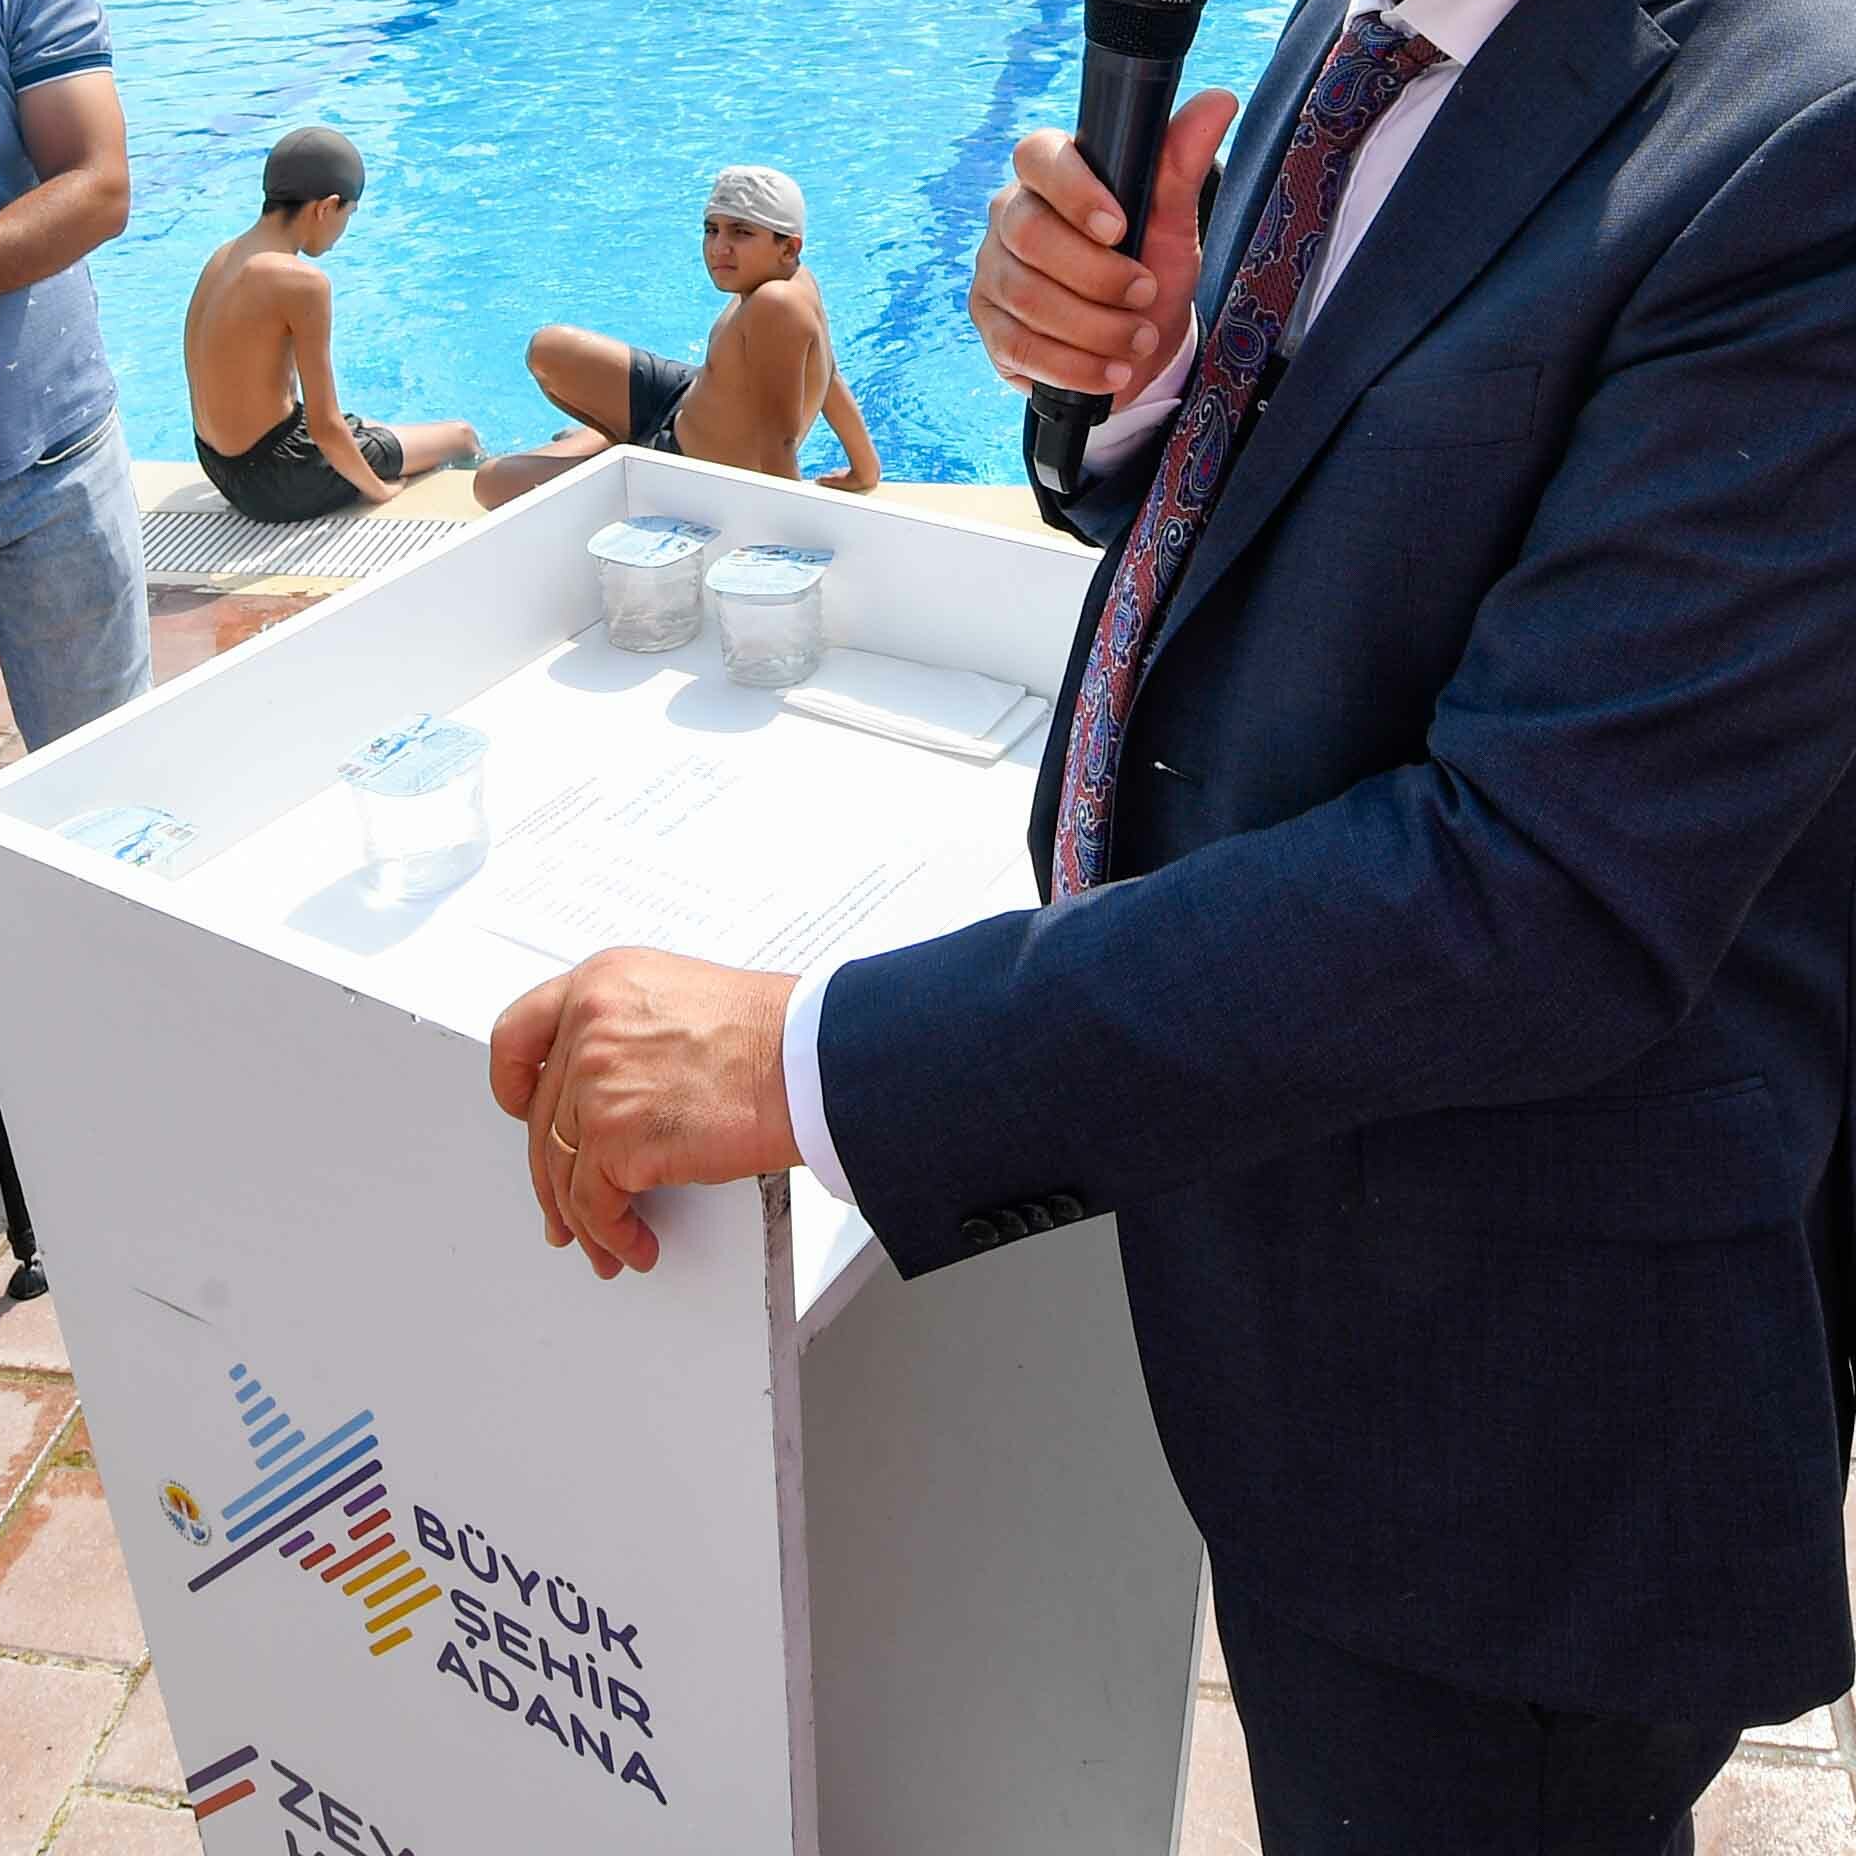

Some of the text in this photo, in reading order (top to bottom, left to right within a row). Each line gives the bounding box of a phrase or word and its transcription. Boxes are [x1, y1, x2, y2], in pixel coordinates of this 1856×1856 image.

[413, 1504, 643, 1670] BÜYÜK
[450, 1589, 654, 1739] ŞEHİR
[436, 1641, 667, 1806] ADANA
